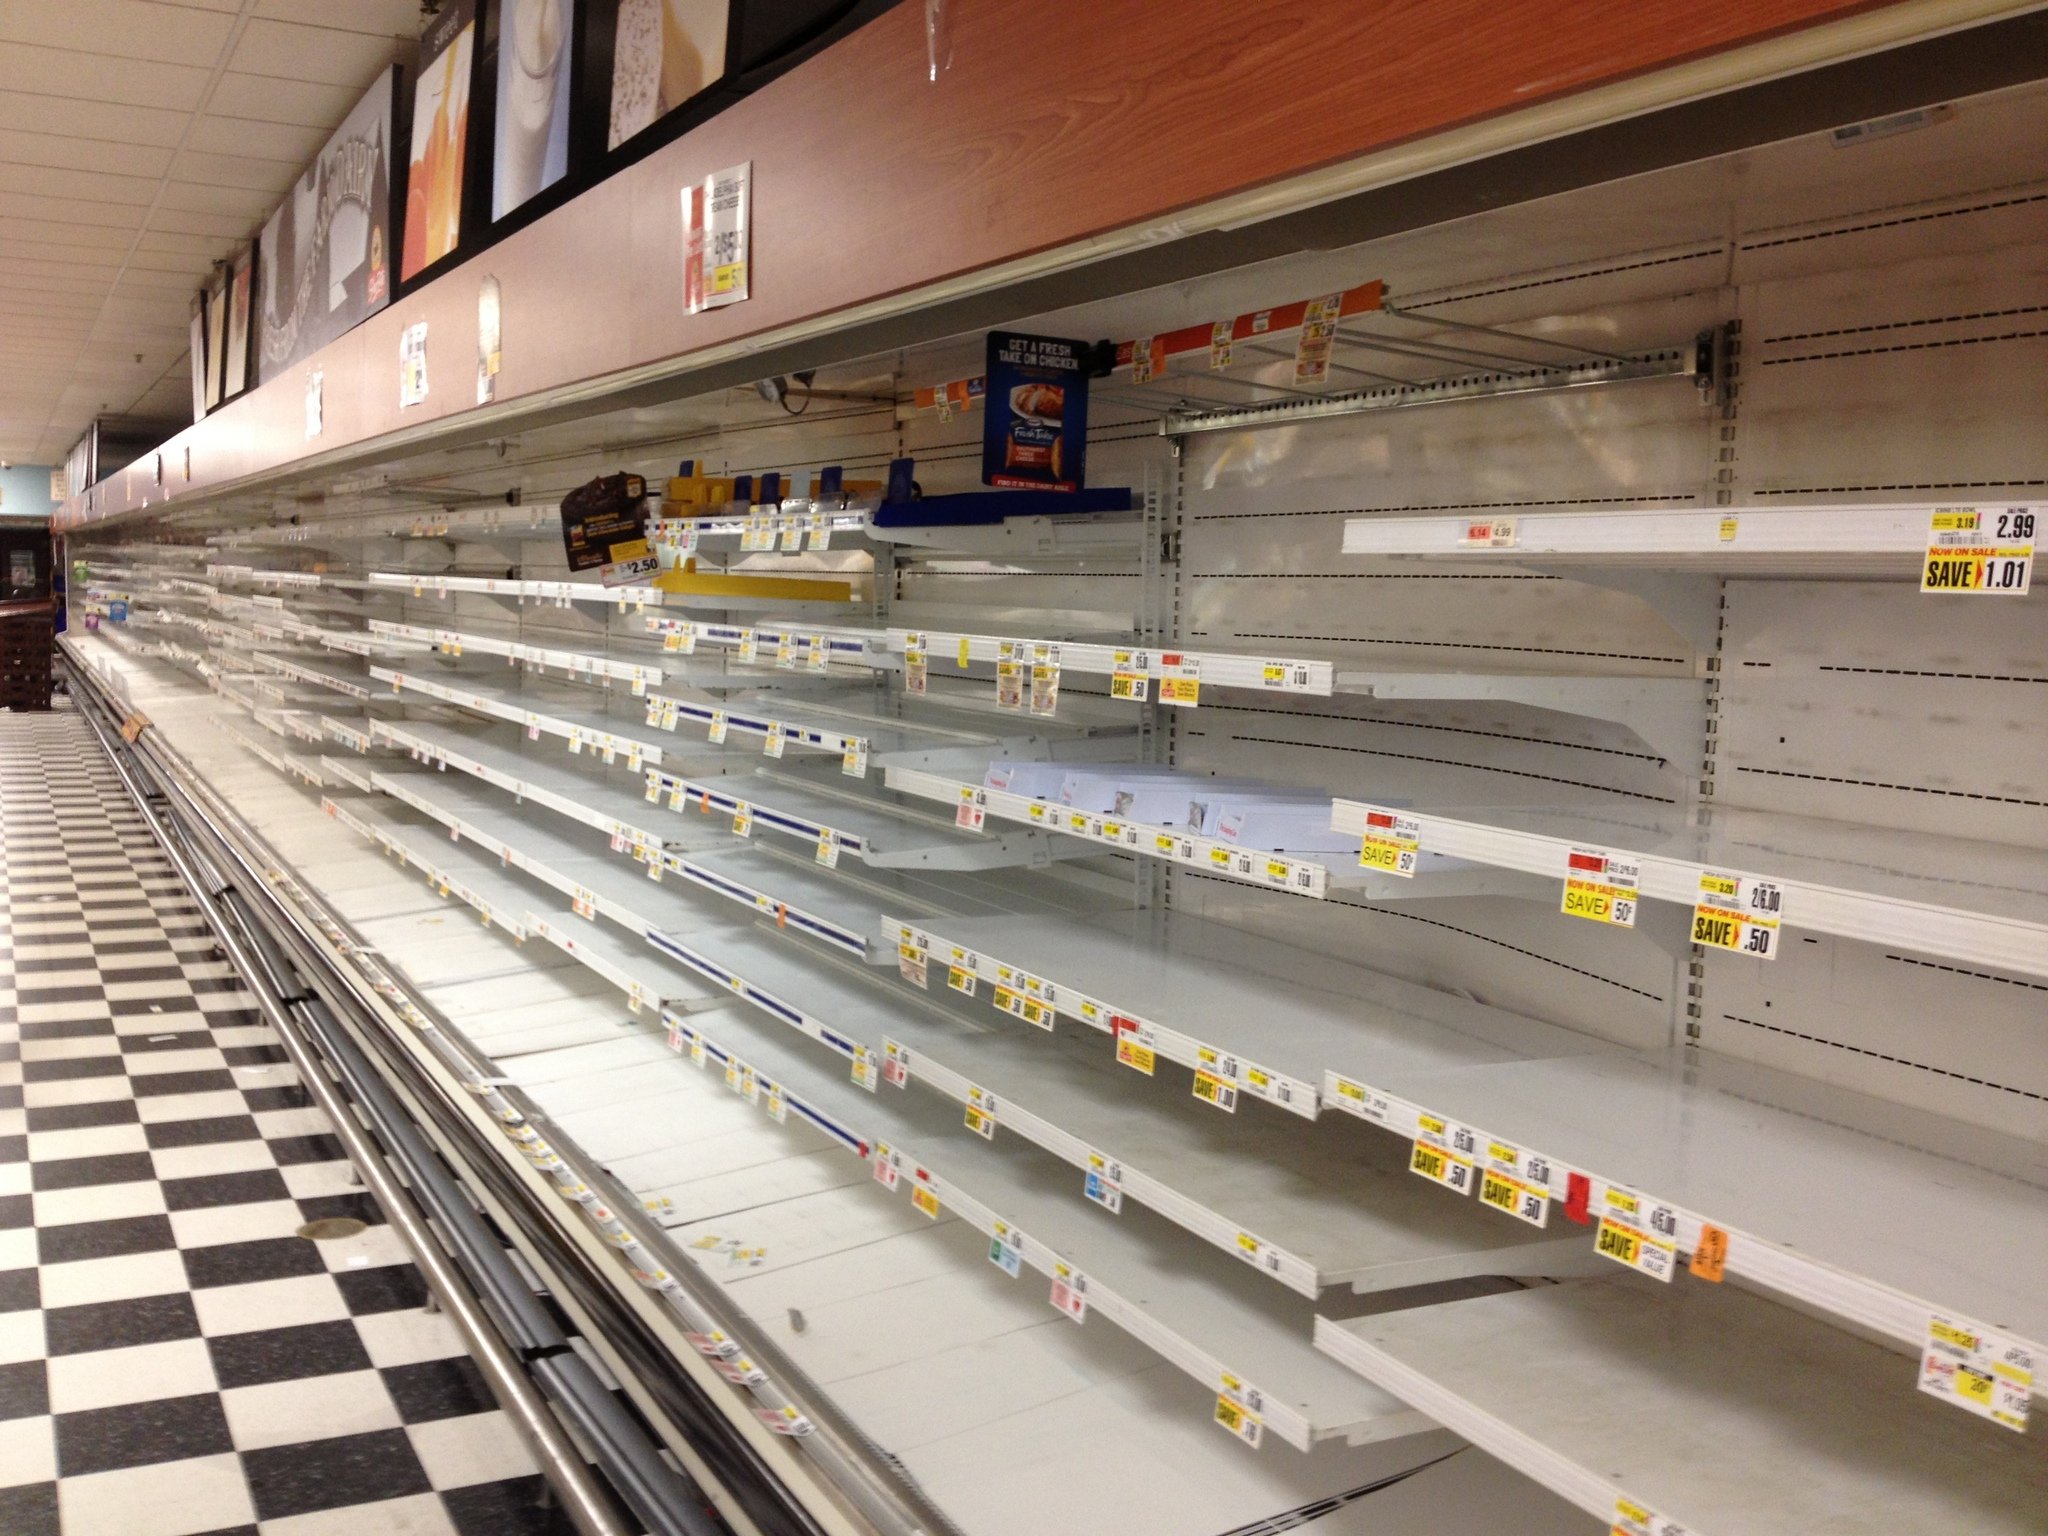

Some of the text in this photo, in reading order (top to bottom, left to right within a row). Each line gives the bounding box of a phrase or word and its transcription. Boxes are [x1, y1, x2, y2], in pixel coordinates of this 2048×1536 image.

[999, 350, 1022, 363] TAKE
[1024, 353, 1037, 365] ON
[1009, 339, 1071, 356] GET A FRESH
[1956, 517, 1975, 528] 3.19
[1997, 514, 2035, 538] 2.99
[1929, 548, 1997, 556] NOW ON SALE
[1926, 561, 1972, 587] SAVE
[1987, 561, 2025, 588] 1.01
[1363, 846, 1392, 865] SAVE
[1565, 892, 1604, 915] SAVE
[1751, 887, 1780, 912] 2/6.00
[1698, 904, 1751, 922] NOW ON SALE
[1695, 917, 1731, 946] SAVE
[1744, 928, 1769, 954] .50
[1414, 1149, 1440, 1177] SAVE
[1484, 1180, 1512, 1208] SAVE
[1599, 1229, 1632, 1260] SAVE
[1642, 1243, 1670, 1265] SPECIAL
[1642, 1259, 1665, 1275] VALUE
